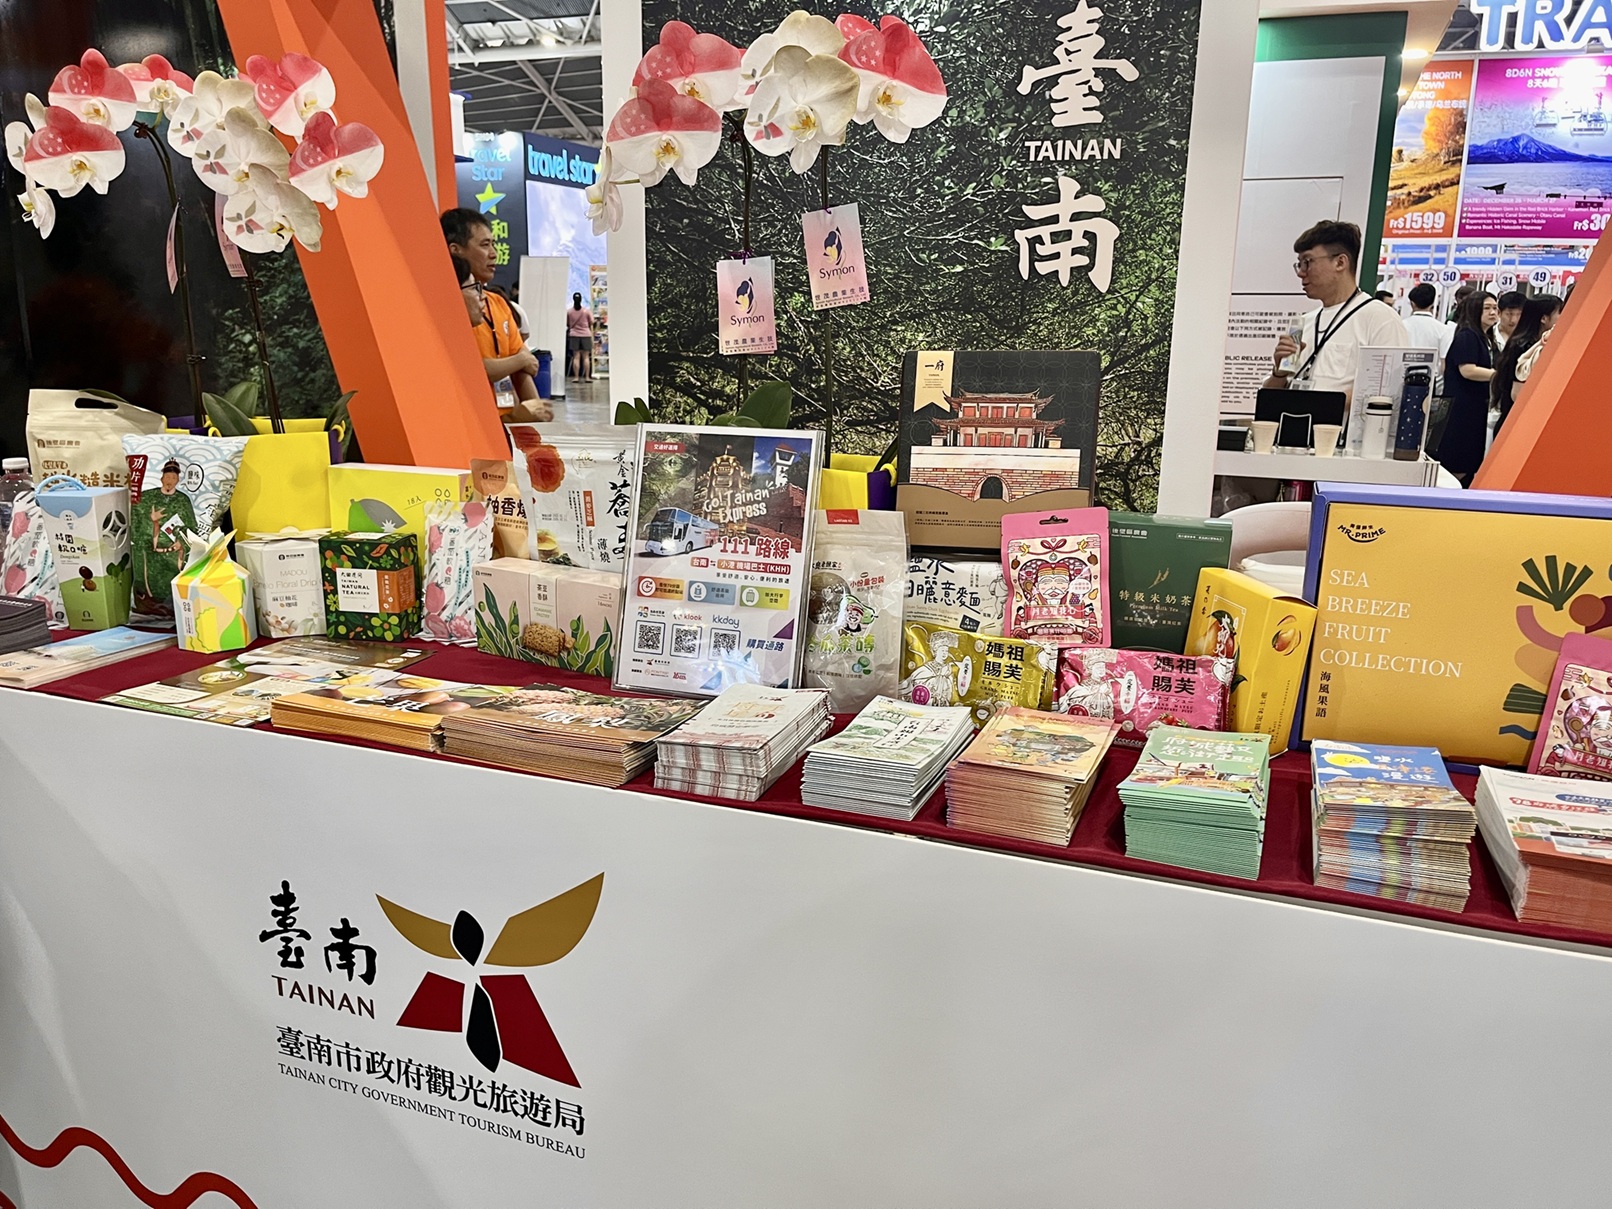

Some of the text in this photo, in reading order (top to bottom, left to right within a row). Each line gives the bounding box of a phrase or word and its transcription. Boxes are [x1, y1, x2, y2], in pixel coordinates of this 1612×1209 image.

[1016, 0, 1140, 127] 臺
[1505, 68, 1532, 77] 8D6N
[1433, 71, 1462, 80] NORTH
[1025, 138, 1121, 161] TAINAN
[472, 164, 505, 181] Star
[528, 144, 596, 184] travel star
[1014, 176, 1120, 293] 南
[819, 265, 855, 280] Symon
[1422, 271, 1434, 281] 32
[1442, 271, 1456, 281] 50
[1501, 276, 1513, 285] 31
[1532, 271, 1546, 281] 49
[730, 314, 765, 327] Symon
[702, 488, 770, 513] Go! Tainan
[718, 501, 768, 524] Express
[720, 536, 792, 560] 111 路線
[280, 569, 308, 577] MADOU
[692, 558, 707, 567] 台南
[736, 562, 766, 572] 機場巴士
[766, 564, 790, 574] (KHH)
[1328, 569, 1370, 588] SEA
[1119, 590, 1192, 607] 特級米奶茶
[1327, 596, 1412, 620] BREEZE
[712, 614, 740, 628] kkday
[1323, 621, 1391, 644] FRUIT
[746, 638, 785, 651] 購買通路
[985, 641, 1025, 662] 媽祖
[982, 660, 1024, 681] 賜芙
[1154, 655, 1198, 675] 媽祖
[1319, 648, 1463, 678] COLLECTION
[1151, 675, 1197, 695] 賜芙
[1315, 671, 1331, 718] 海風果語
[259, 880, 377, 985] 臺南
[271, 974, 376, 1020] TAINAN
[276, 1025, 587, 1137] 臺南市政府觀光旅遊局
[278, 1062, 587, 1160] TAINAN CITY GOVERNMENT TOURISM BUREAU
